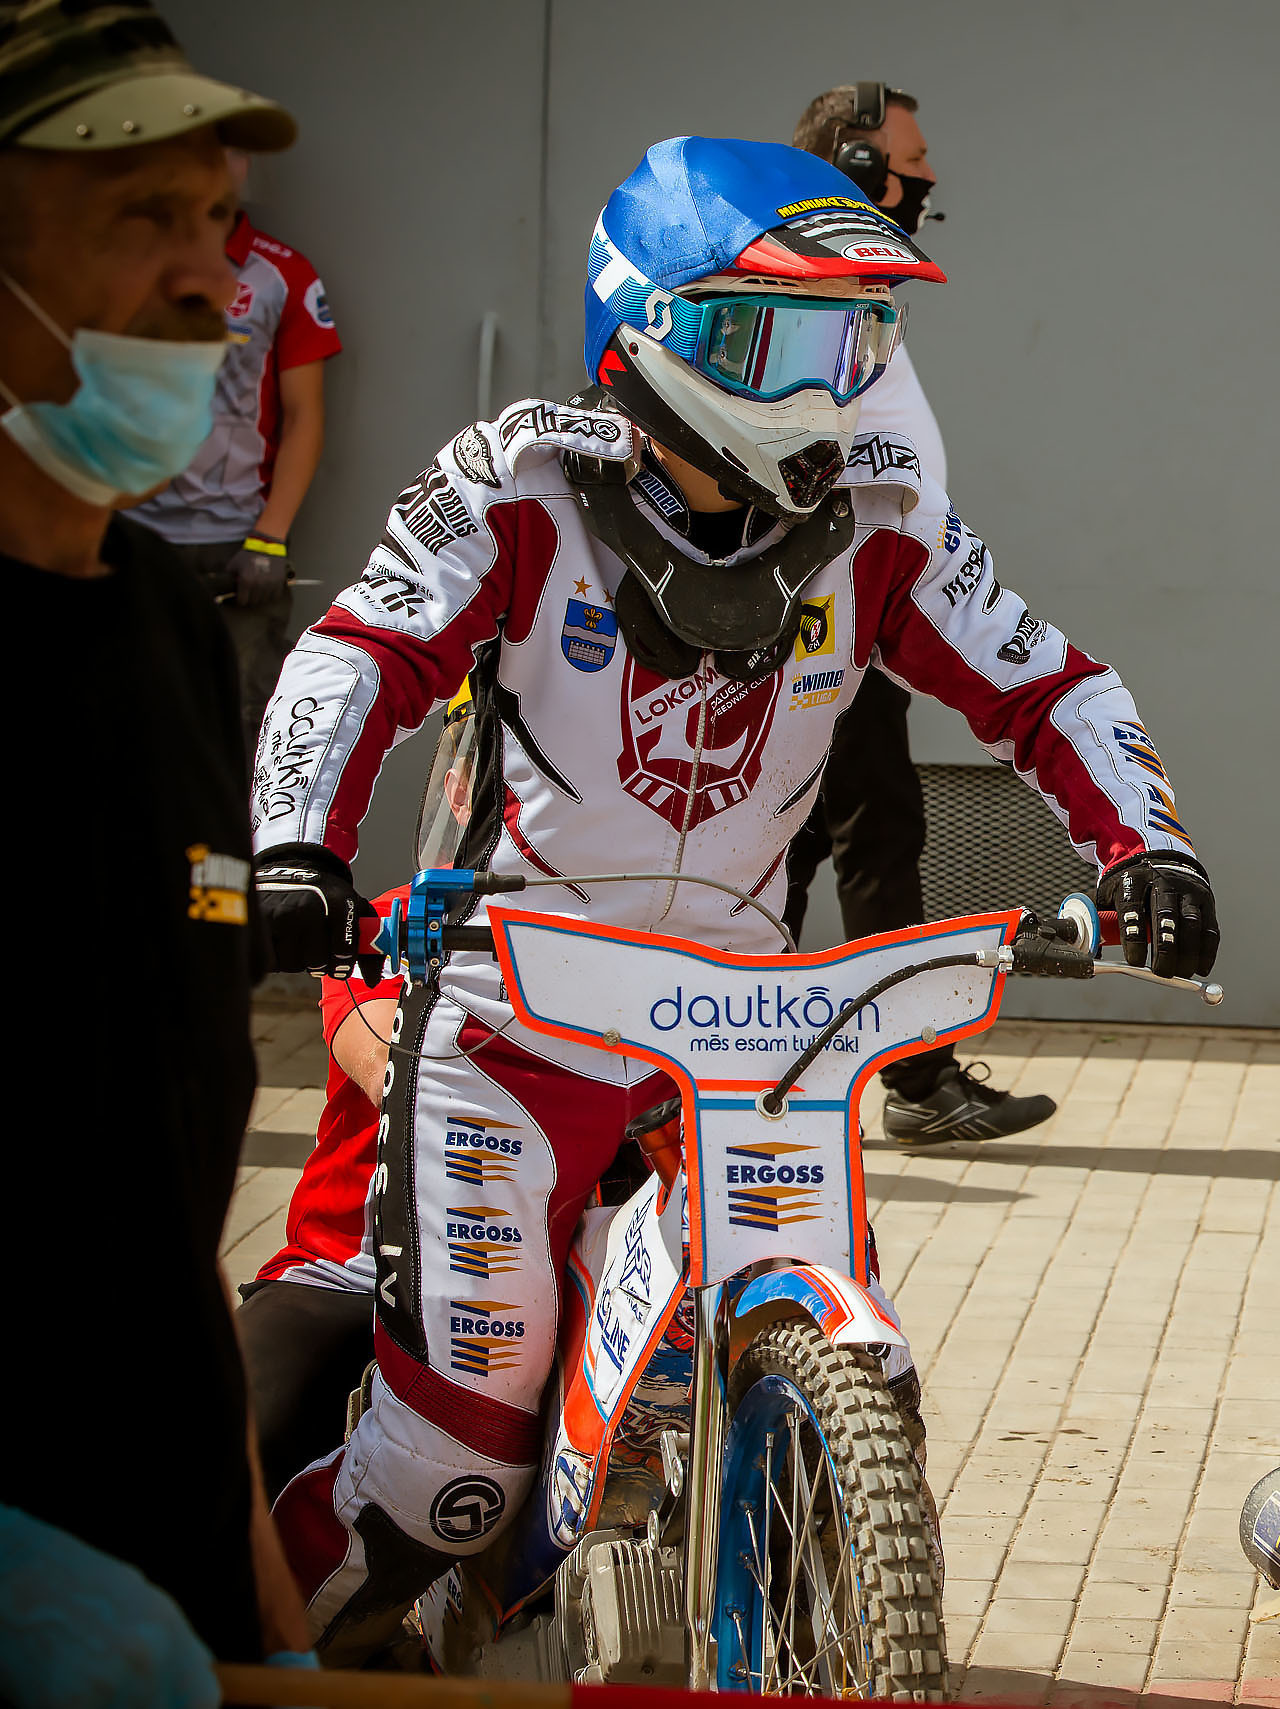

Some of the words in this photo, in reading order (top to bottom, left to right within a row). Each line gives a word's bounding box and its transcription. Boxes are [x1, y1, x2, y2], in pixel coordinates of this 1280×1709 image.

[853, 247, 911, 260] BELL
[690, 1034, 729, 1052] mēs
[735, 1037, 787, 1052] esam
[445, 1131, 523, 1156] ERGOSS
[726, 1164, 824, 1185] ERGOSS
[446, 1222, 523, 1243] ERGOSS
[450, 1316, 525, 1338] ERGOSS
